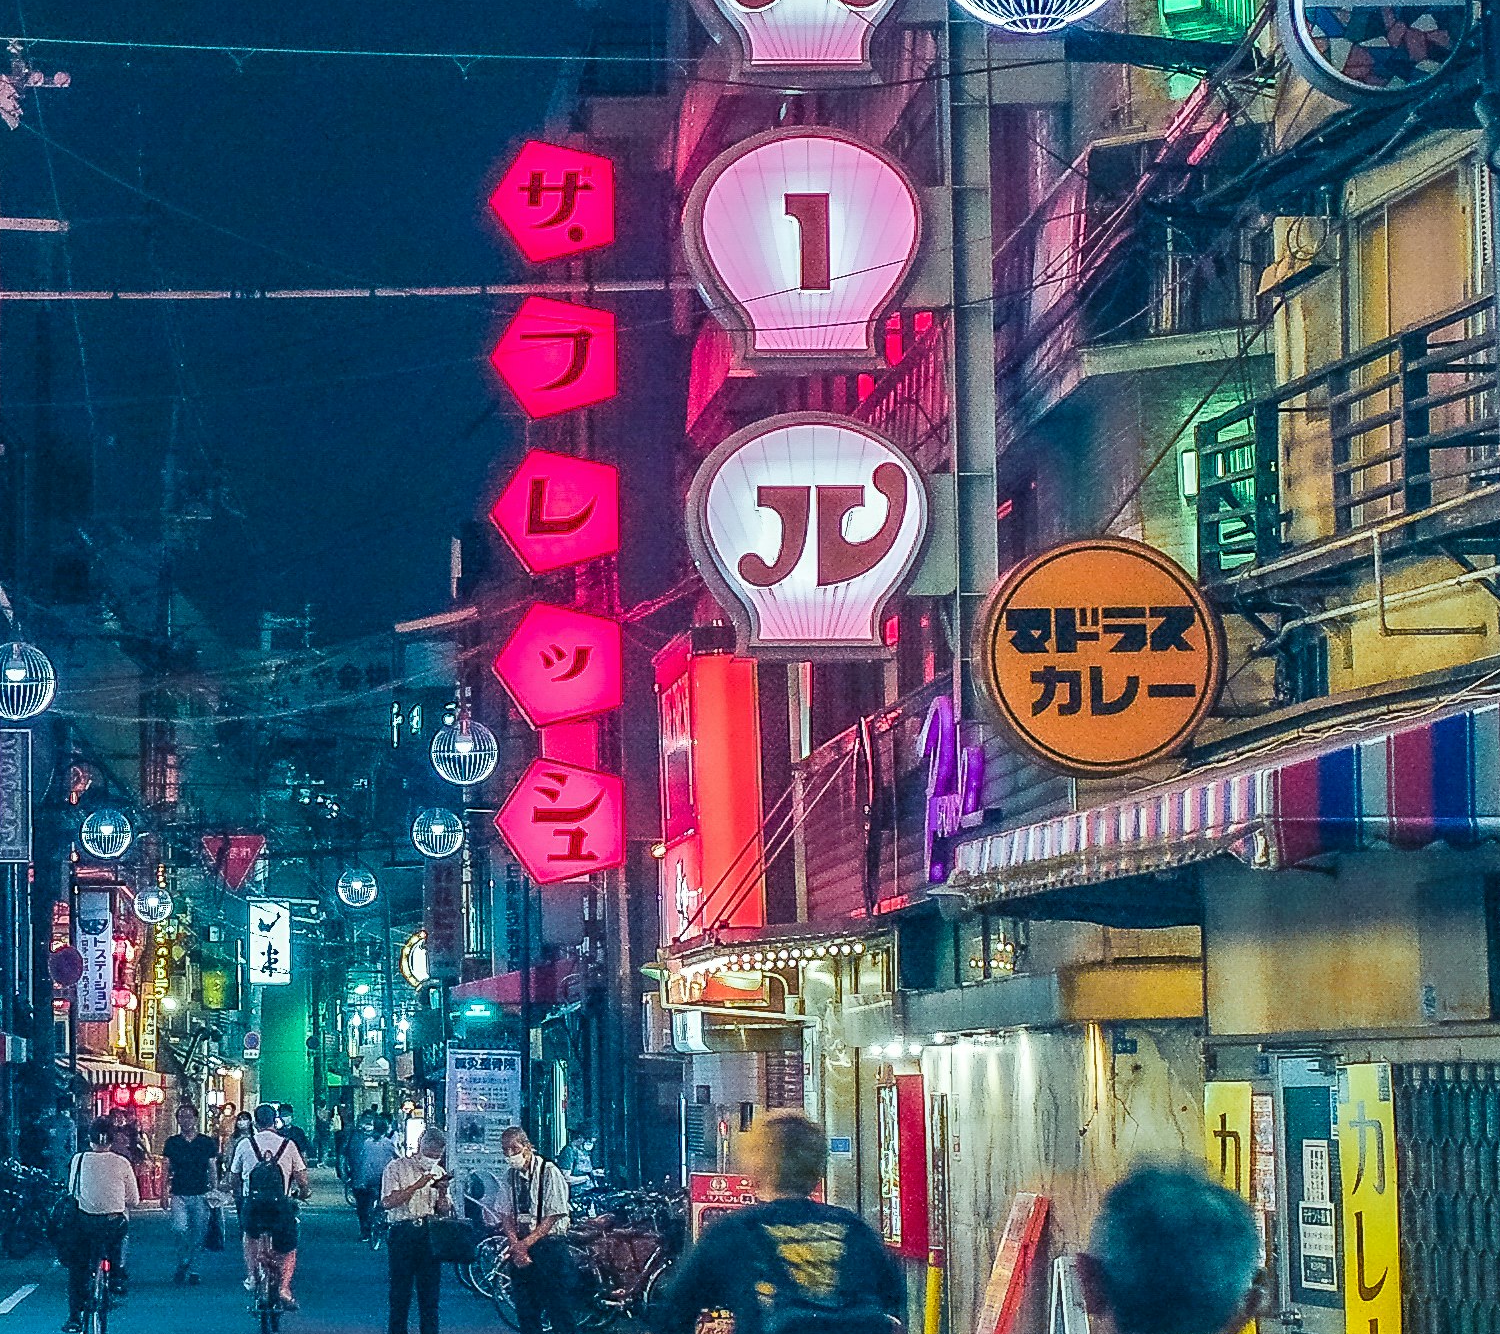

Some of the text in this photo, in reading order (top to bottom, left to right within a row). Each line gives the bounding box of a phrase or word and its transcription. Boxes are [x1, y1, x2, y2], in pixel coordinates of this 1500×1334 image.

[1005, 606, 1197, 655] マドラス
[1029, 668, 1198, 717] カレー
